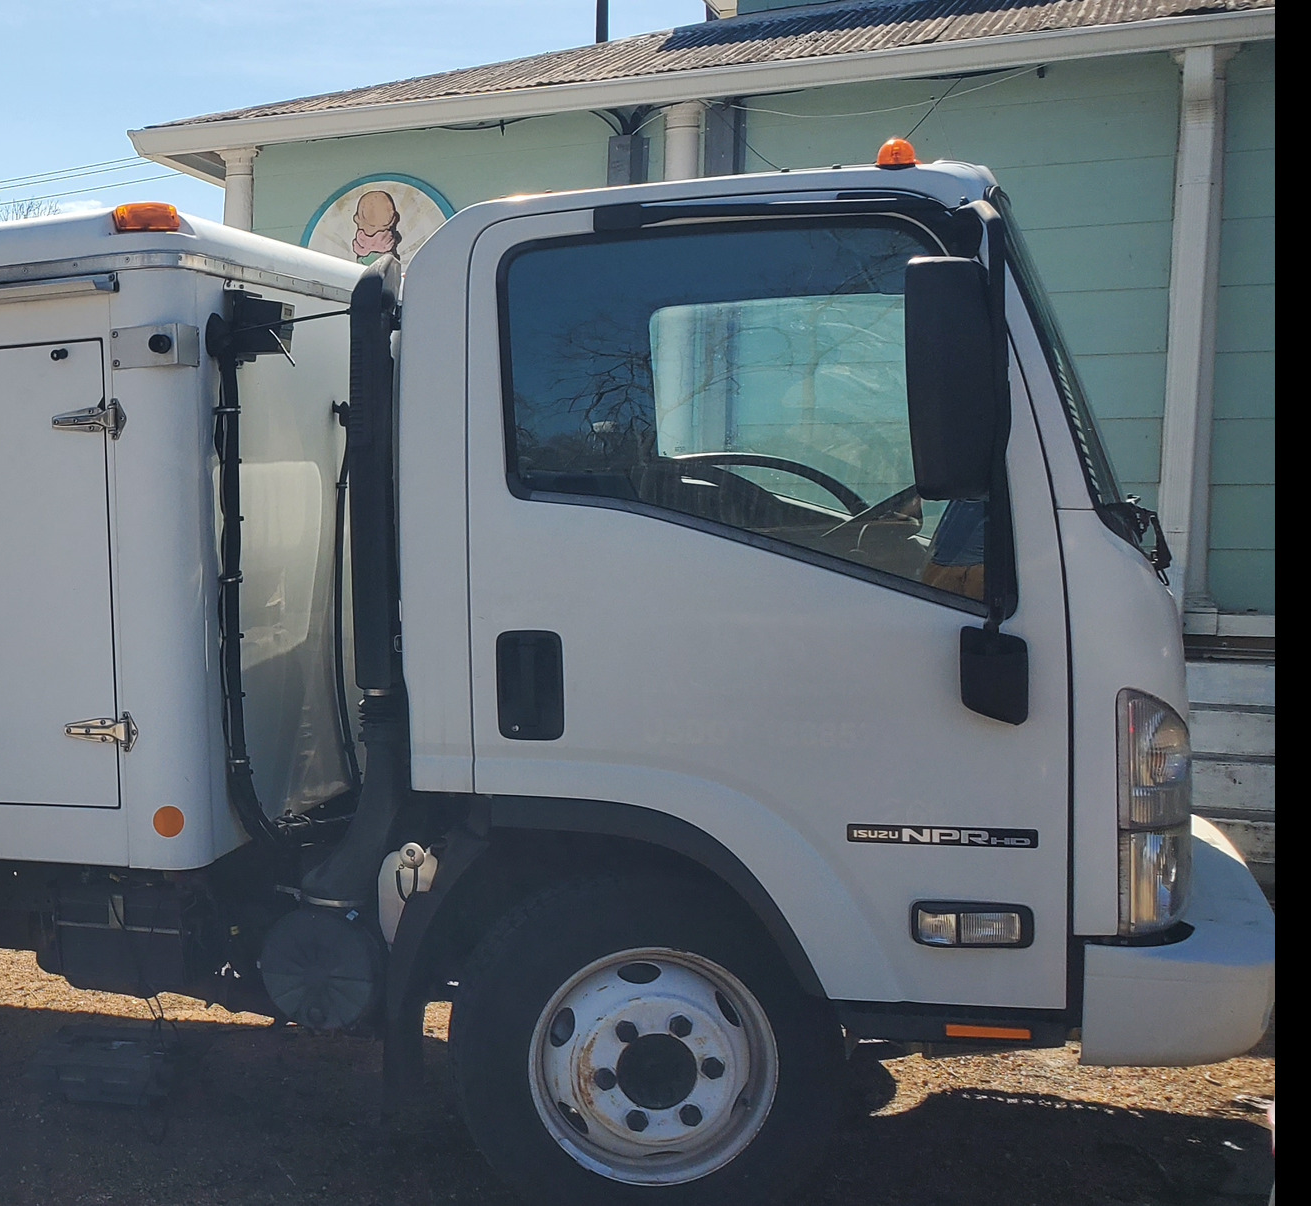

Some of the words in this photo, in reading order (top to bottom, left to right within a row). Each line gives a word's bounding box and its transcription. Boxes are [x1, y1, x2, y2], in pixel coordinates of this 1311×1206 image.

[853, 829, 899, 839] ISUZU
[901, 828, 989, 845] NPR
[991, 837, 1031, 846] HD
